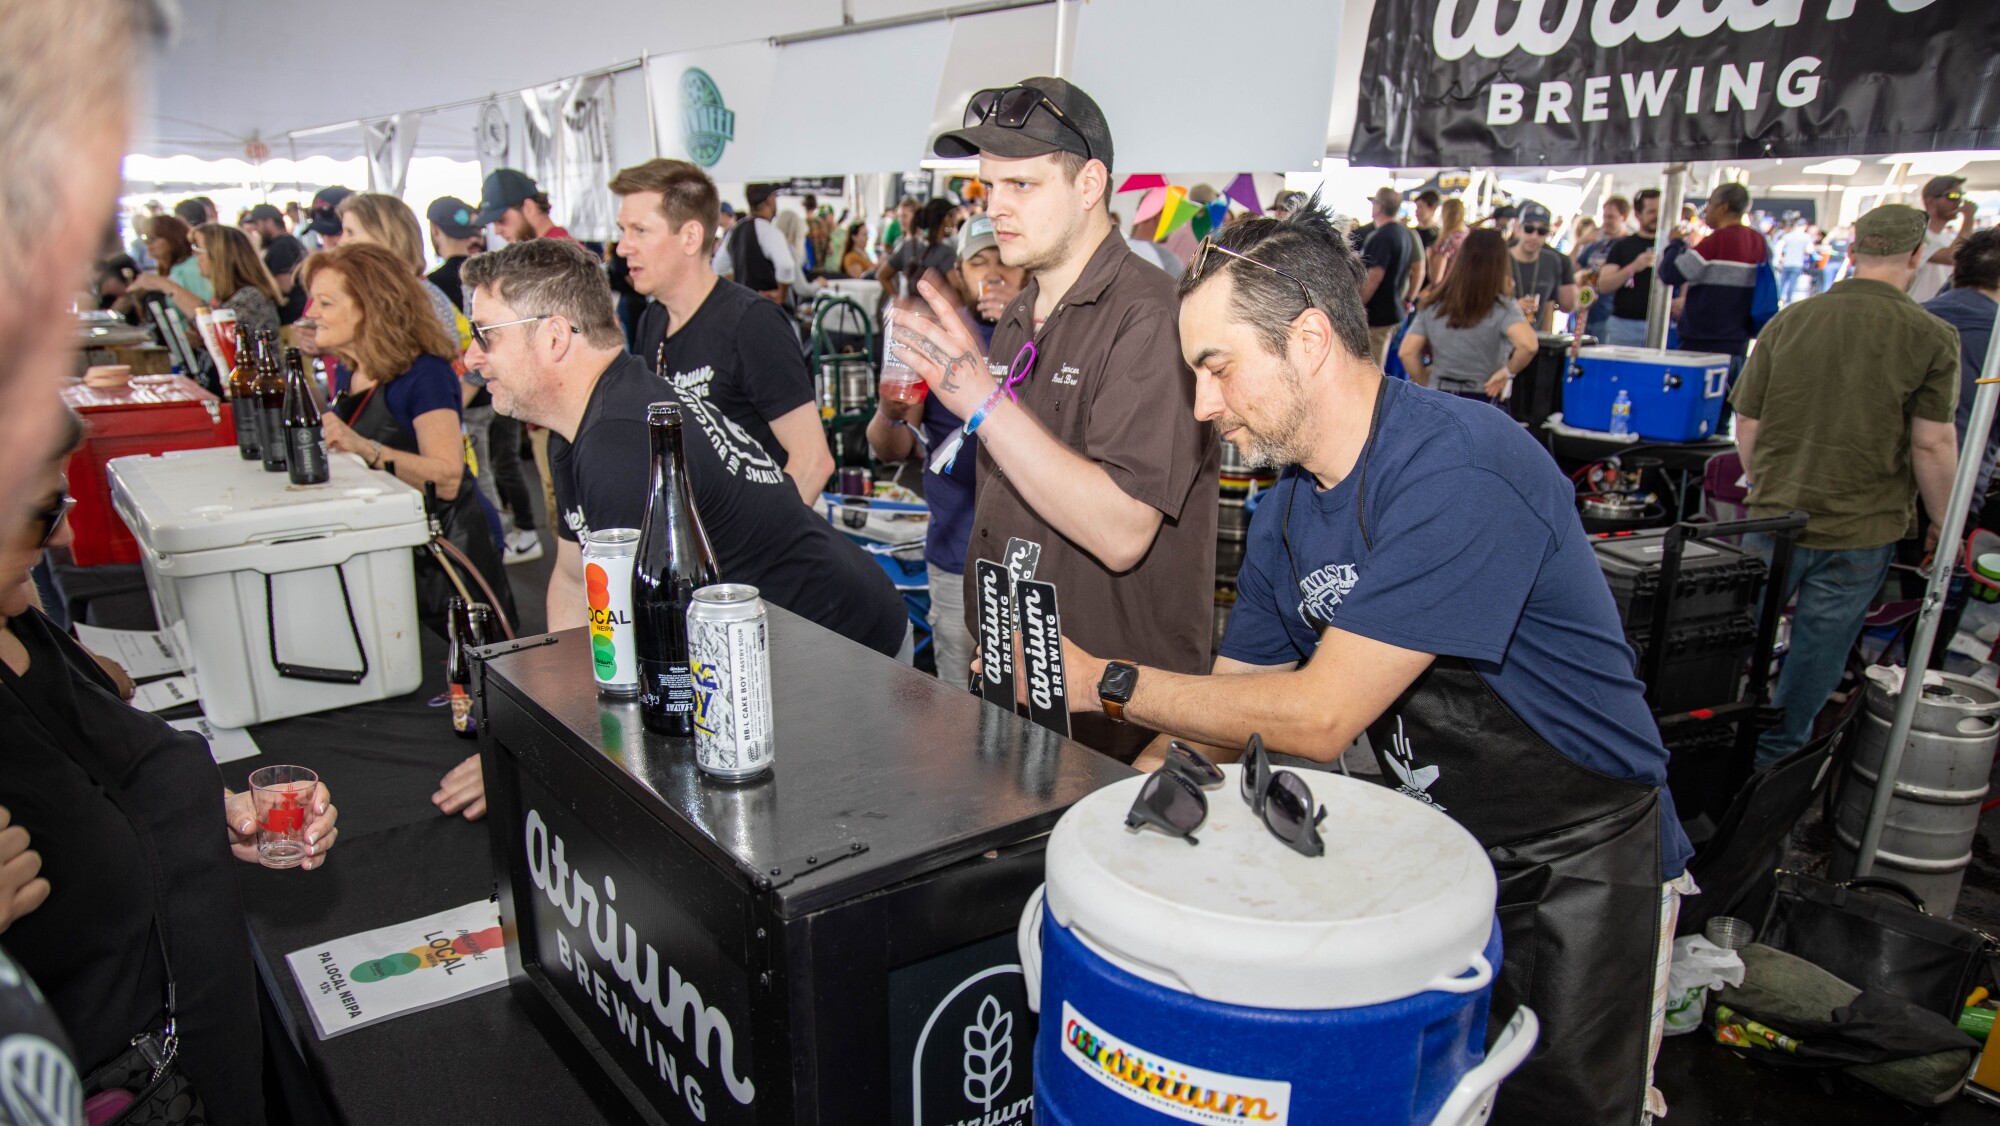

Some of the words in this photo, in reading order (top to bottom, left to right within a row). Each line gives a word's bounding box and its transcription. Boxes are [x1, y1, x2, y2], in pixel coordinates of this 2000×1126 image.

[1486, 56, 1823, 126] BREWING
[981, 569, 1002, 685] atrium
[1000, 595, 1012, 674] BREWING
[1025, 588, 1052, 710] atrium
[1046, 614, 1063, 697] BREWING
[318, 951, 332, 965] PA
[325, 962, 347, 991] LOCAL
[338, 990, 363, 1019] NEIPA
[318, 981, 333, 995] 13%
[423, 930, 466, 976] LOCAL
[525, 809, 756, 1104] atrium
[557, 929, 706, 1122] BREWING
